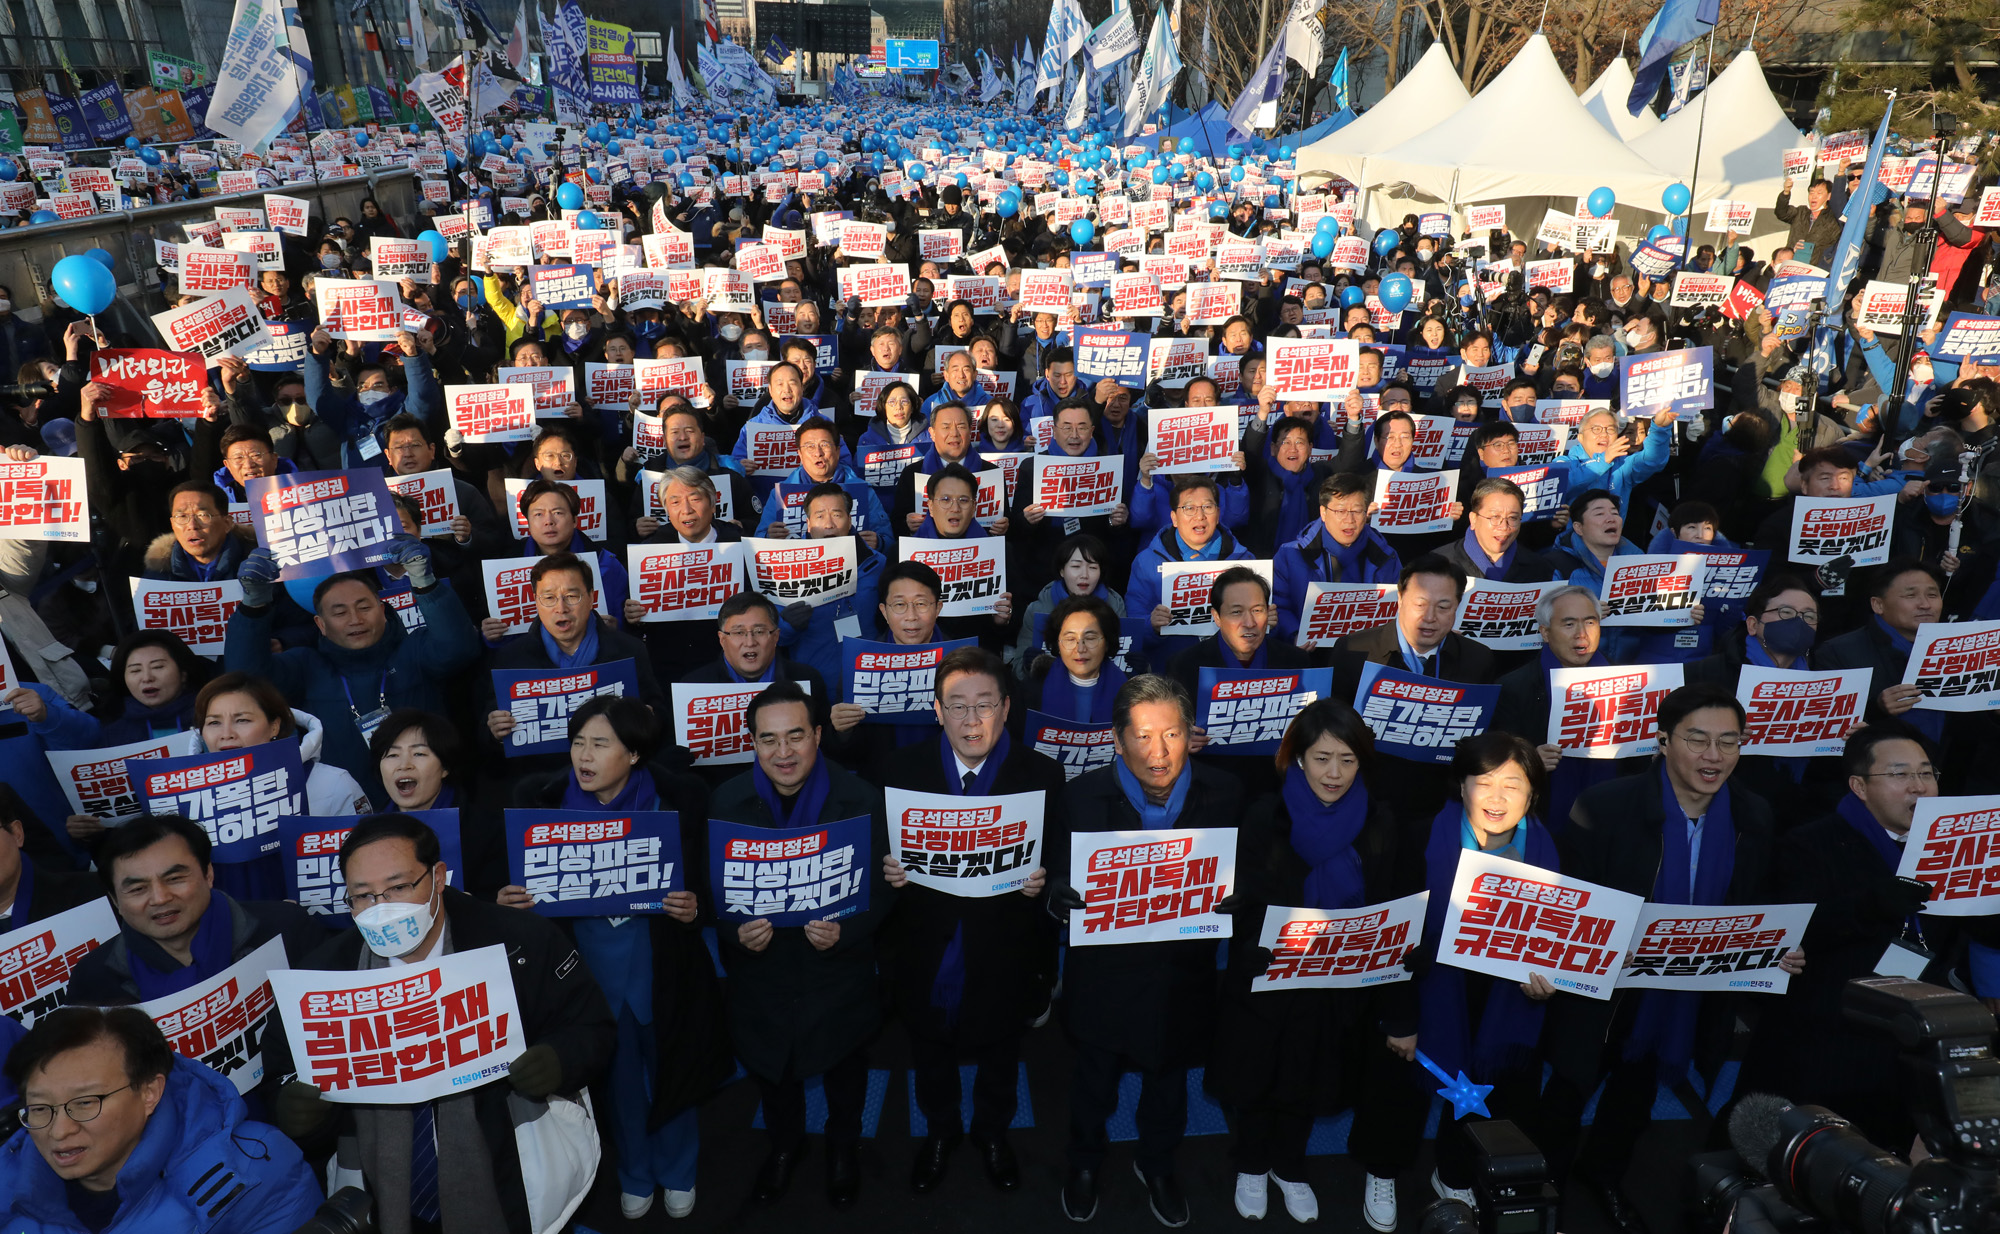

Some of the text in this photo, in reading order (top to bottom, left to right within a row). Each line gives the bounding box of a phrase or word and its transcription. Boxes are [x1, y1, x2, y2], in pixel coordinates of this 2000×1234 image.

[593, 84, 640, 100] 수사하라
[843, 232, 882, 244] 검사독재
[843, 241, 883, 252] 규탄한다!
[189, 253, 235, 263] 윤석열정권
[378, 253, 427, 264] 난방비폭탄
[185, 263, 251, 278] 검사독재
[378, 263, 431, 275] 못살겠다!
[185, 276, 254, 291] 규탄한다!
[328, 286, 376, 299] 윤석열정권
[535, 276, 587, 293] 민생파탄
[857, 275, 904, 290] 검사독재
[858, 285, 908, 301] 규탄한다!
[1024, 283, 1069, 296] 검사독재
[1115, 285, 1159, 301] 검사독재
[1678, 284, 1727, 293] 난방비폭탄
[325, 297, 394, 315] 검사독재
[1023, 295, 1072, 307] 규탄한다!
[1115, 296, 1163, 312] 규탄한다!
[1190, 294, 1236, 309] 검사독재
[1675, 291, 1727, 303] 못살겠다!
[174, 302, 224, 331] 윤석열정권
[325, 313, 401, 333] 규탄한다!
[1188, 304, 1239, 321] 규탄한다!
[175, 303, 249, 350] 난방비폭탄
[1083, 335, 1125, 346] 윤석열정권
[1078, 345, 1142, 363] 물가폭탄
[1278, 345, 1330, 359] 윤석열정권
[98, 357, 191, 380] 내려와라
[594, 370, 632, 379] 윤석열정권
[643, 363, 683, 377] 윤석열정권
[1076, 357, 1143, 377] 해결하라!
[1274, 354, 1349, 375] 검사독재
[1468, 369, 1504, 380] 윤석열정권
[642, 370, 698, 391] 검사독재
[1275, 371, 1354, 393] 규탄한다!
[1627, 363, 1703, 393] 민생파탄
[141, 379, 202, 405] 윤석열
[458, 389, 506, 405] 윤석열정권
[456, 398, 525, 422] 검사독재
[458, 413, 531, 437] 규탄한다!
[1161, 413, 1210, 432] 윤석열정권
[1157, 423, 1229, 450] 검사독재
[869, 447, 911, 462] 윤석열정권
[1158, 440, 1235, 467] 규탄한다!
[1047, 464, 1096, 477] 윤석열정권
[1040, 470, 1113, 494] 검사독재
[1389, 478, 1437, 493] 윤석열정권
[266, 479, 343, 508] 윤석열정권
[1041, 486, 1118, 511] 규탄한다!
[1381, 486, 1450, 510] 검사독재
[264, 493, 378, 537] 민생파탄
[1378, 503, 1451, 527] 규탄한다!
[1809, 505, 1872, 521] 윤석열정권
[1800, 514, 1886, 538] 난방비폭탄
[270, 516, 394, 569] 못살겠다!
[1797, 529, 1889, 556] 못살겠다!
[645, 551, 708, 570] 윤석열정권
[758, 549, 820, 563] 윤석열정권
[914, 549, 974, 565] 윤석열정권
[639, 563, 732, 593] 검사독재
[756, 557, 845, 579] 난방비폭탄
[1617, 563, 1672, 580] 윤석열정권
[758, 569, 853, 598] 못살겠다!
[1609, 575, 1692, 598] 난방비폭탄
[148, 590, 217, 605] 윤석열정권
[1321, 591, 1381, 604] 윤석열정권
[1473, 590, 1536, 604] 윤석열정권
[1607, 591, 1697, 616] 못살겠다!
[1312, 600, 1398, 622] 검사독재
[1463, 604, 1536, 621] 난방비폭
[861, 651, 936, 669] 윤석열정권
[515, 674, 592, 696] 윤석열정권
[1218, 678, 1292, 697] 윤석열정권
[1379, 681, 1458, 702] 윤석열정권
[1570, 675, 1642, 700] 윤석열정권
[1760, 679, 1836, 698] 윤석열정권
[1364, 696, 1482, 731] 물가폭탄
[1747, 693, 1859, 722] 검사독재
[1042, 728, 1114, 744] 윤석열정권
[150, 757, 246, 794] 윤석열정권
[907, 808, 994, 827] 윤석열정권
[531, 820, 624, 842] 윤석열정권
[901, 820, 1027, 852] 난방비폭탄
[731, 834, 820, 858] 윤석열정권
[1095, 840, 1184, 869] 윤석열정권
[524, 837, 661, 877] 민생파탄
[724, 843, 855, 888] 민생파탄
[901, 839, 1036, 878] 못살겠다!
[525, 863, 675, 905] 못살겠다!
[1086, 856, 1219, 903] 검사독재
[725, 868, 864, 917] 못살겠다!
[1480, 875, 1581, 909] 윤석열정권
[1083, 884, 1227, 934] 규탄한다!
[1179, 924, 1220, 935] 더불어민주당
[1288, 913, 1381, 936] 윤석열정권
[1460, 895, 1616, 947] 검사독재
[1654, 916, 1756, 935] 윤석열정권
[1271, 920, 1412, 957] 검사독재
[1640, 928, 1787, 955] 난방비폭탄
[1453, 925, 1618, 976] 규탄한다!
[1266, 943, 1414, 982] 규탄한다!
[1627, 946, 1791, 978] 못살겠다!
[1361, 972, 1401, 984] 더불어민주당
[1554, 978, 1599, 995] 더불어민주당
[1729, 980, 1774, 988] 더불어민주당
[308, 975, 431, 1017] 윤석열정권
[304, 982, 488, 1057] 검사독재
[311, 1013, 508, 1093] 규탄한다!
[452, 1061, 510, 1088] 더불어민주당
